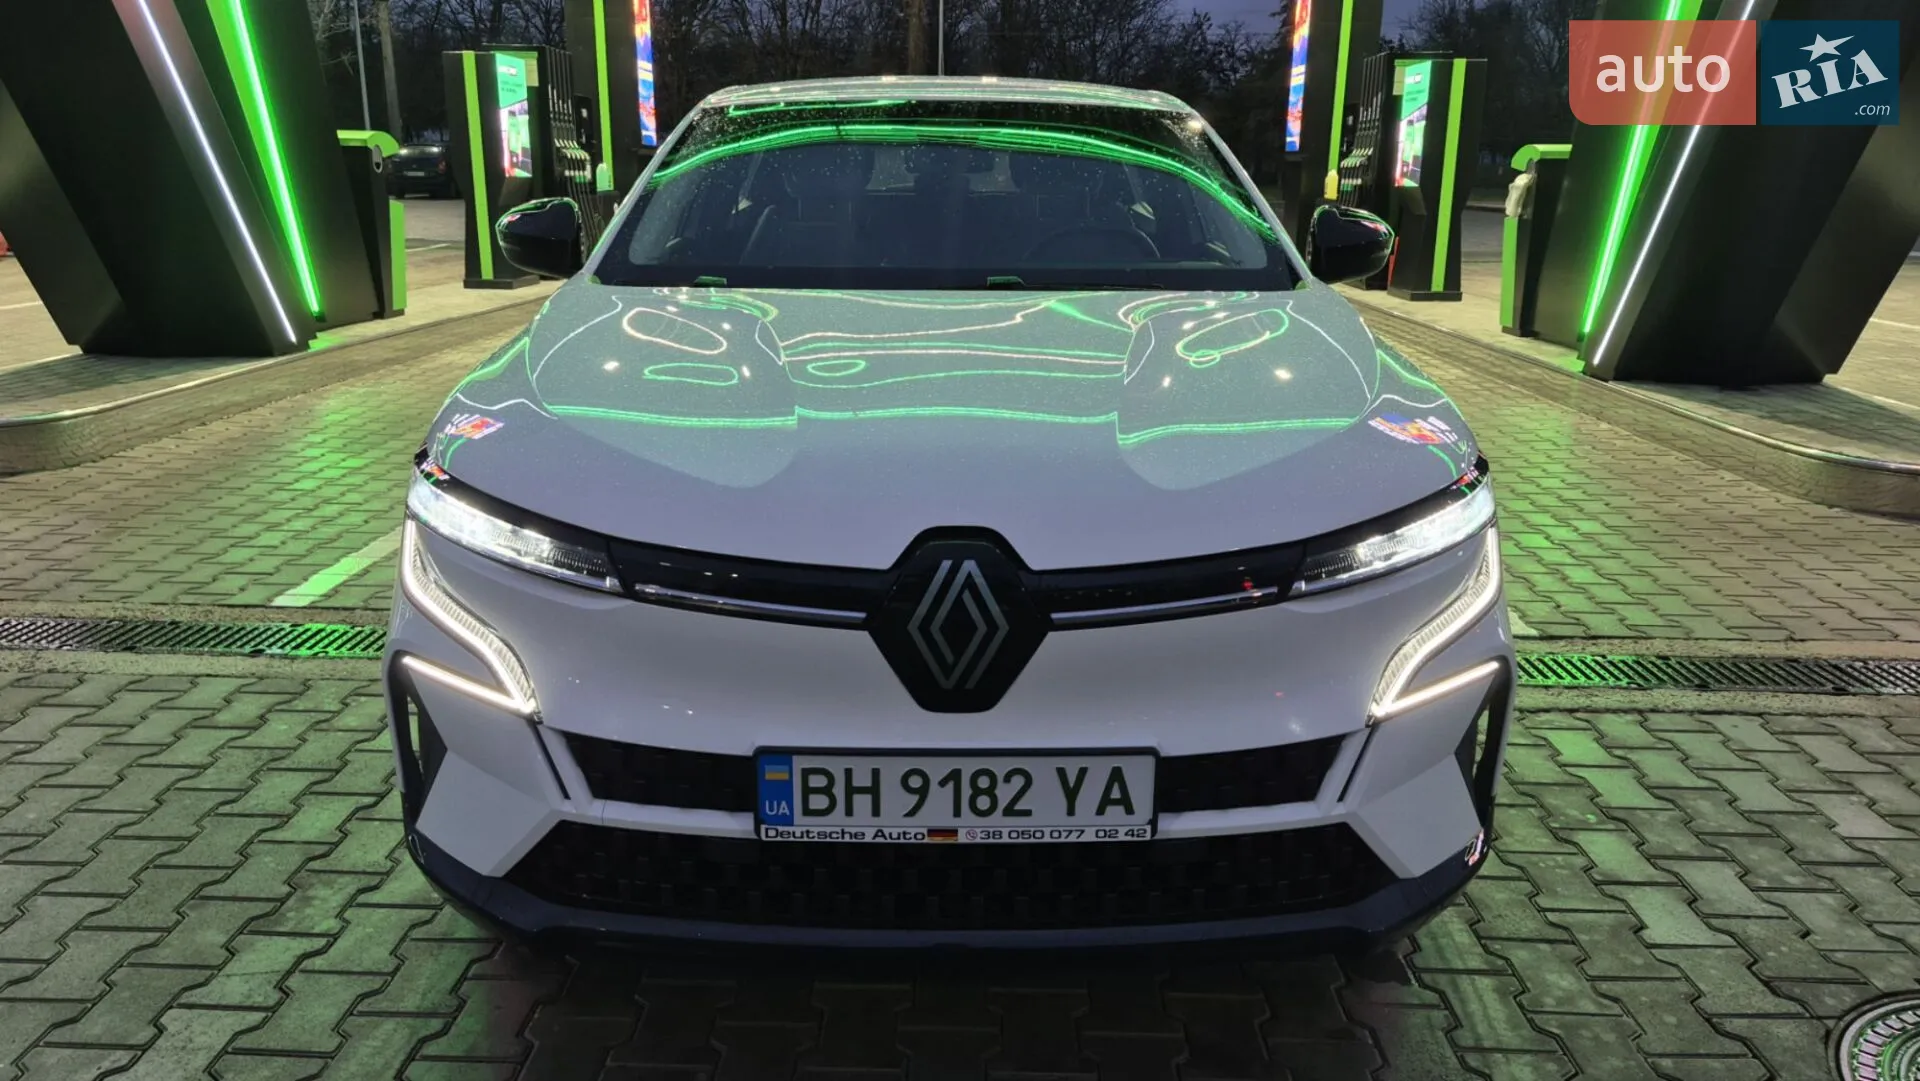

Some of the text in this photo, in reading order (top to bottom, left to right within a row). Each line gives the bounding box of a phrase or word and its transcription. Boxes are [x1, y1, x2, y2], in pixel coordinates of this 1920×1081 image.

[801, 766, 1136, 818] BH 9182 YA
[765, 800, 790, 816] UA
[764, 827, 926, 841] Deutsche Auto
[979, 828, 1148, 840] 38 050 077 02 42
